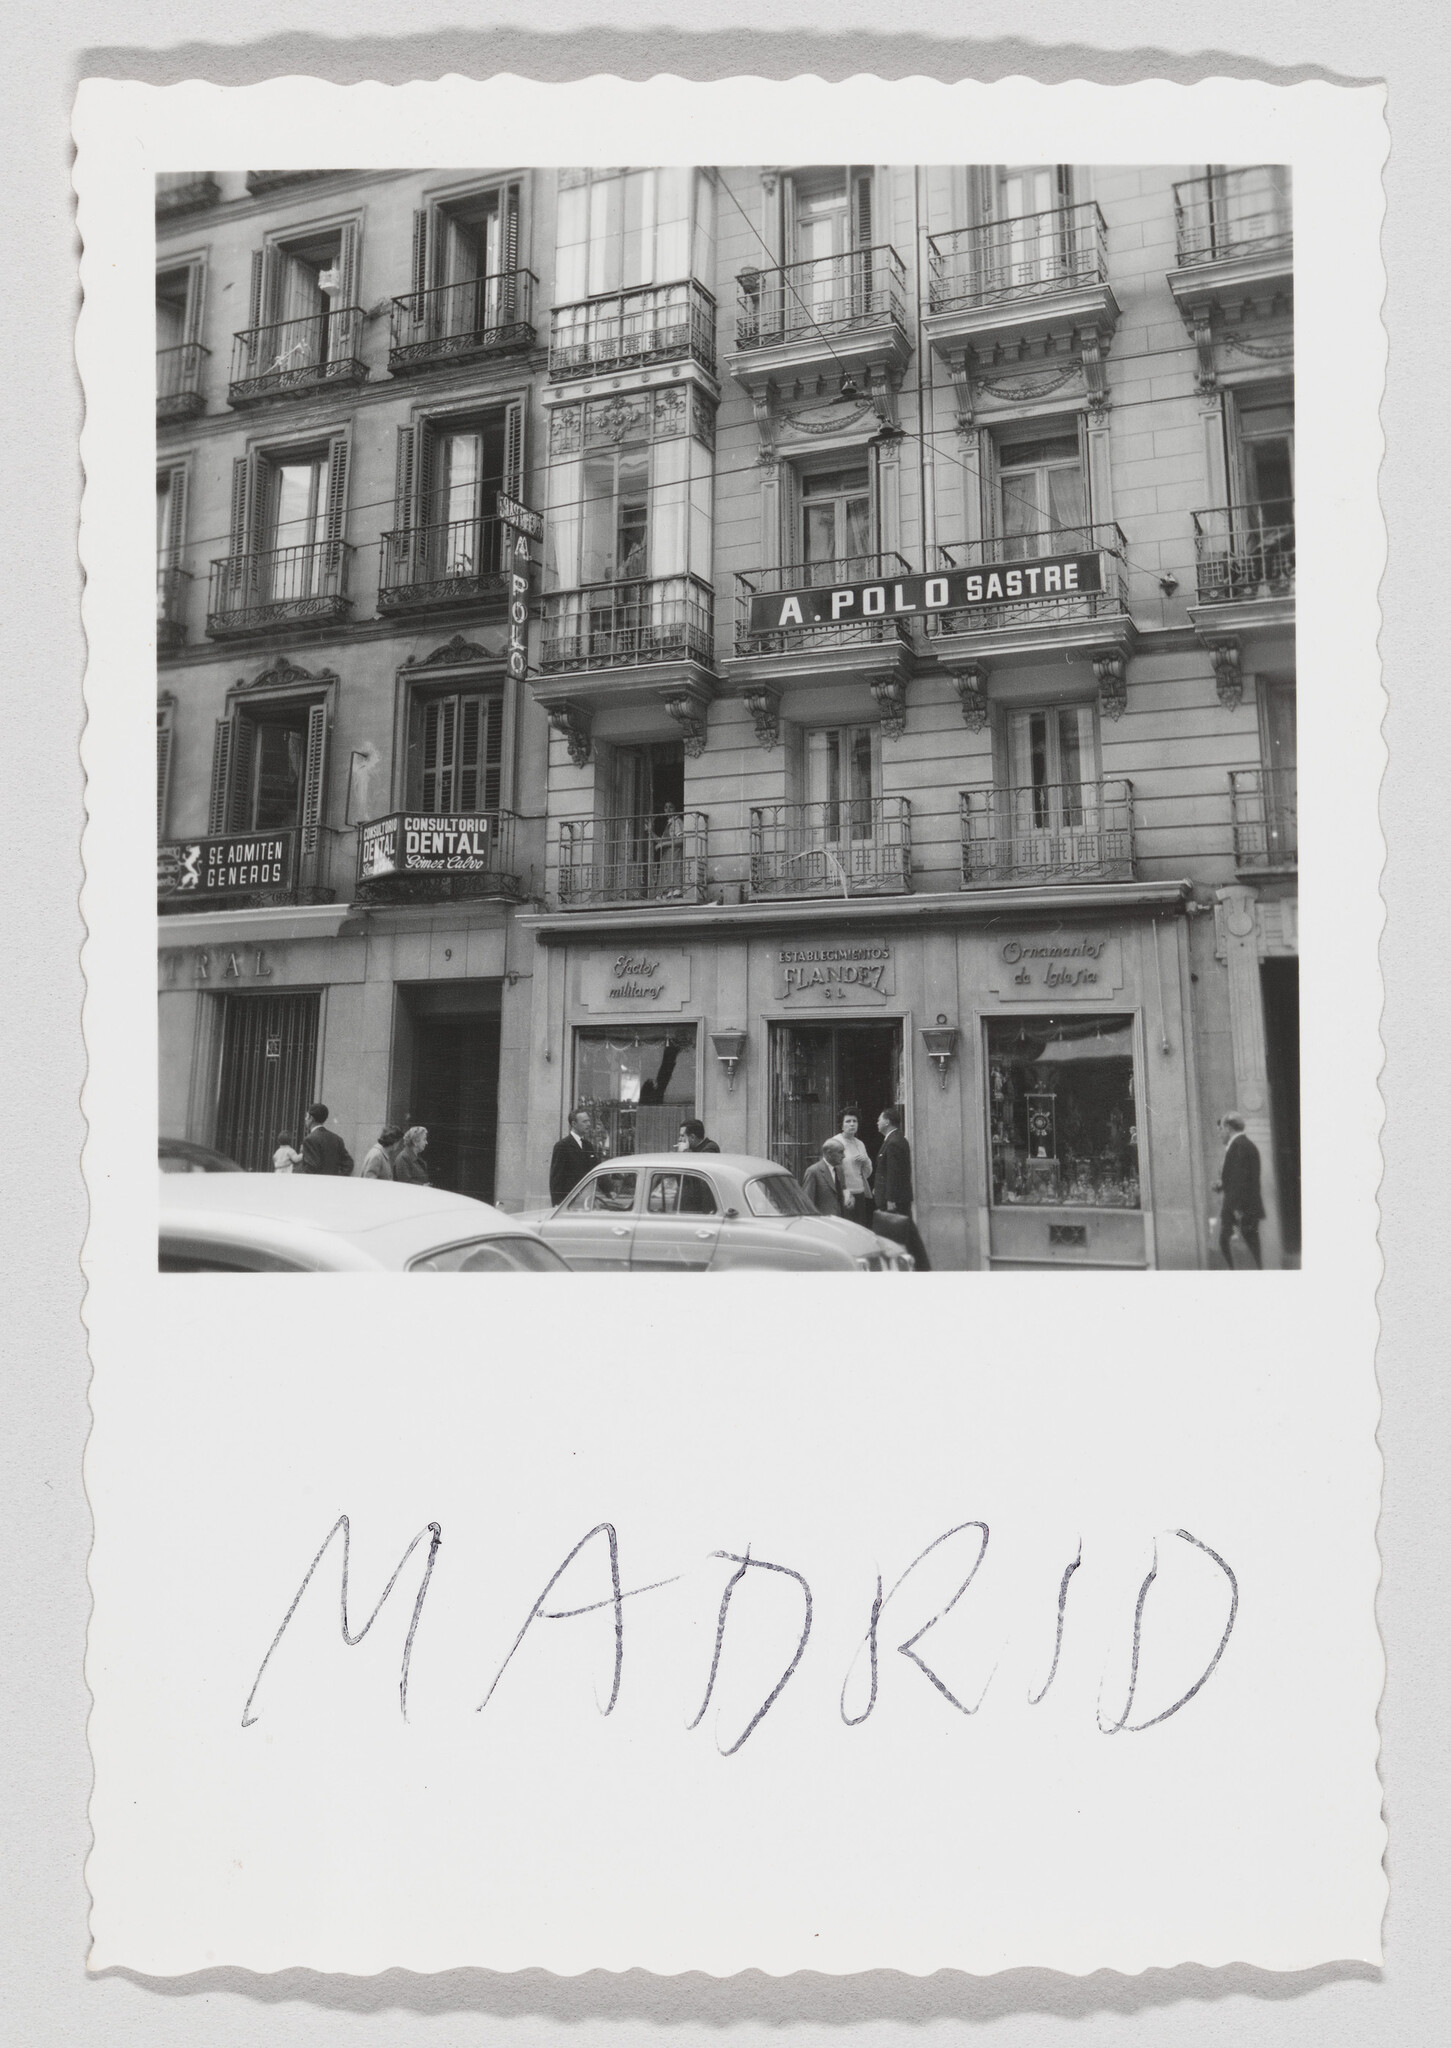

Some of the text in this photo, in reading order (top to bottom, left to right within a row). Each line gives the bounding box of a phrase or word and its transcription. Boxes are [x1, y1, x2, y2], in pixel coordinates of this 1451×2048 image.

[831, 577, 949, 617] POLO
[966, 563, 1079, 602] SASTRE
[510, 573, 529, 674] POLO
[404, 817, 488, 833] CONSULTORIO
[208, 841, 283, 865] SE ADMITEN
[361, 833, 396, 863] DENTAL
[405, 831, 485, 855] DENTAL
[446, 855, 484, 870] Calvo
[207, 863, 281, 887] GENEROS
[444, 947, 453, 962] 9
[779, 947, 890, 963] ESTABLECIMIENTOS
[1003, 938, 1105, 965] Ornamentos
[613, 955, 660, 979] Efectos
[1014, 962, 1099, 988] de Iglesia
[609, 981, 665, 1001] militares
[784, 965, 887, 997] FLANDEZ
[241, 1513, 1239, 1758] MADRID
